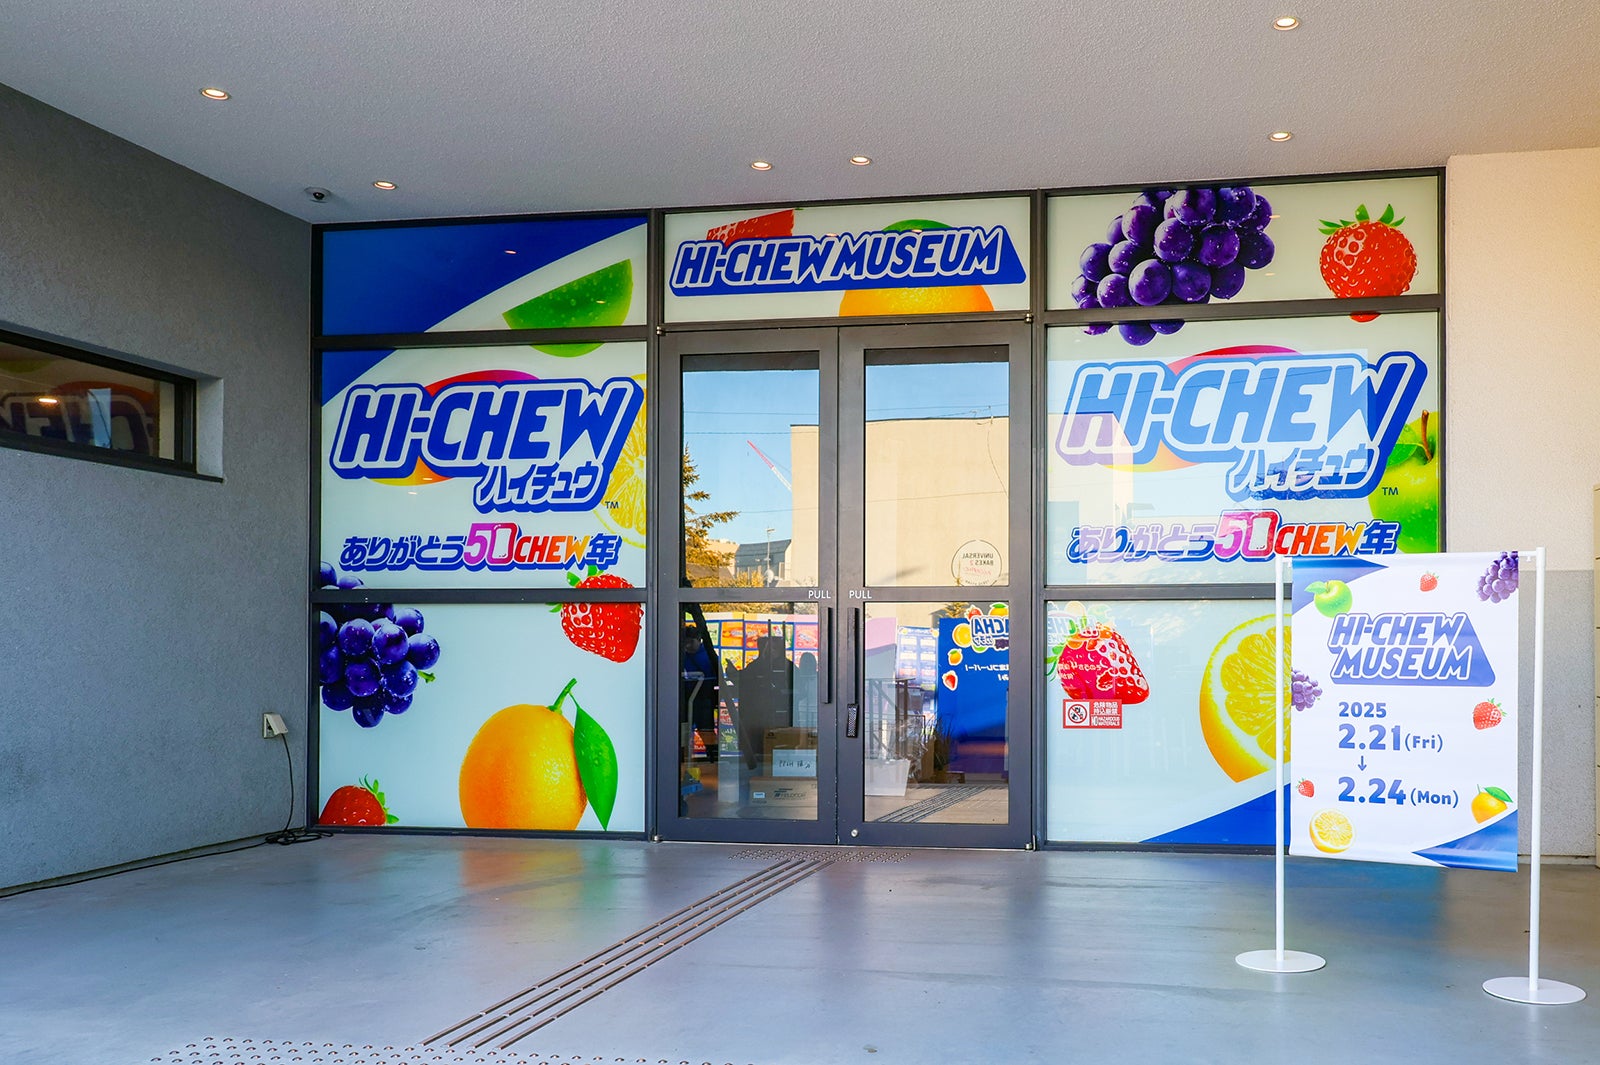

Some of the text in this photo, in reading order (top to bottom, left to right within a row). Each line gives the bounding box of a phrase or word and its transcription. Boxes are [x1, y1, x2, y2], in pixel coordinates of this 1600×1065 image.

[674, 229, 1001, 286] HI-CHEW MUSEUM
[1065, 358, 1411, 450] HI-CHEW
[337, 384, 631, 466] HI-CHEW
[478, 461, 603, 503] ハイチュウ
[1235, 444, 1371, 490] ハイチュウ
[808, 590, 831, 599] PULL
[849, 590, 872, 599] PULL
[1331, 614, 1463, 646] HI-CHEW
[1334, 646, 1472, 679] MUSEUM
[1338, 701, 1387, 718] 2025
[1338, 724, 1443, 752] 2.21 (Fri)
[1338, 776, 1459, 808] 2.24 (Mon)
